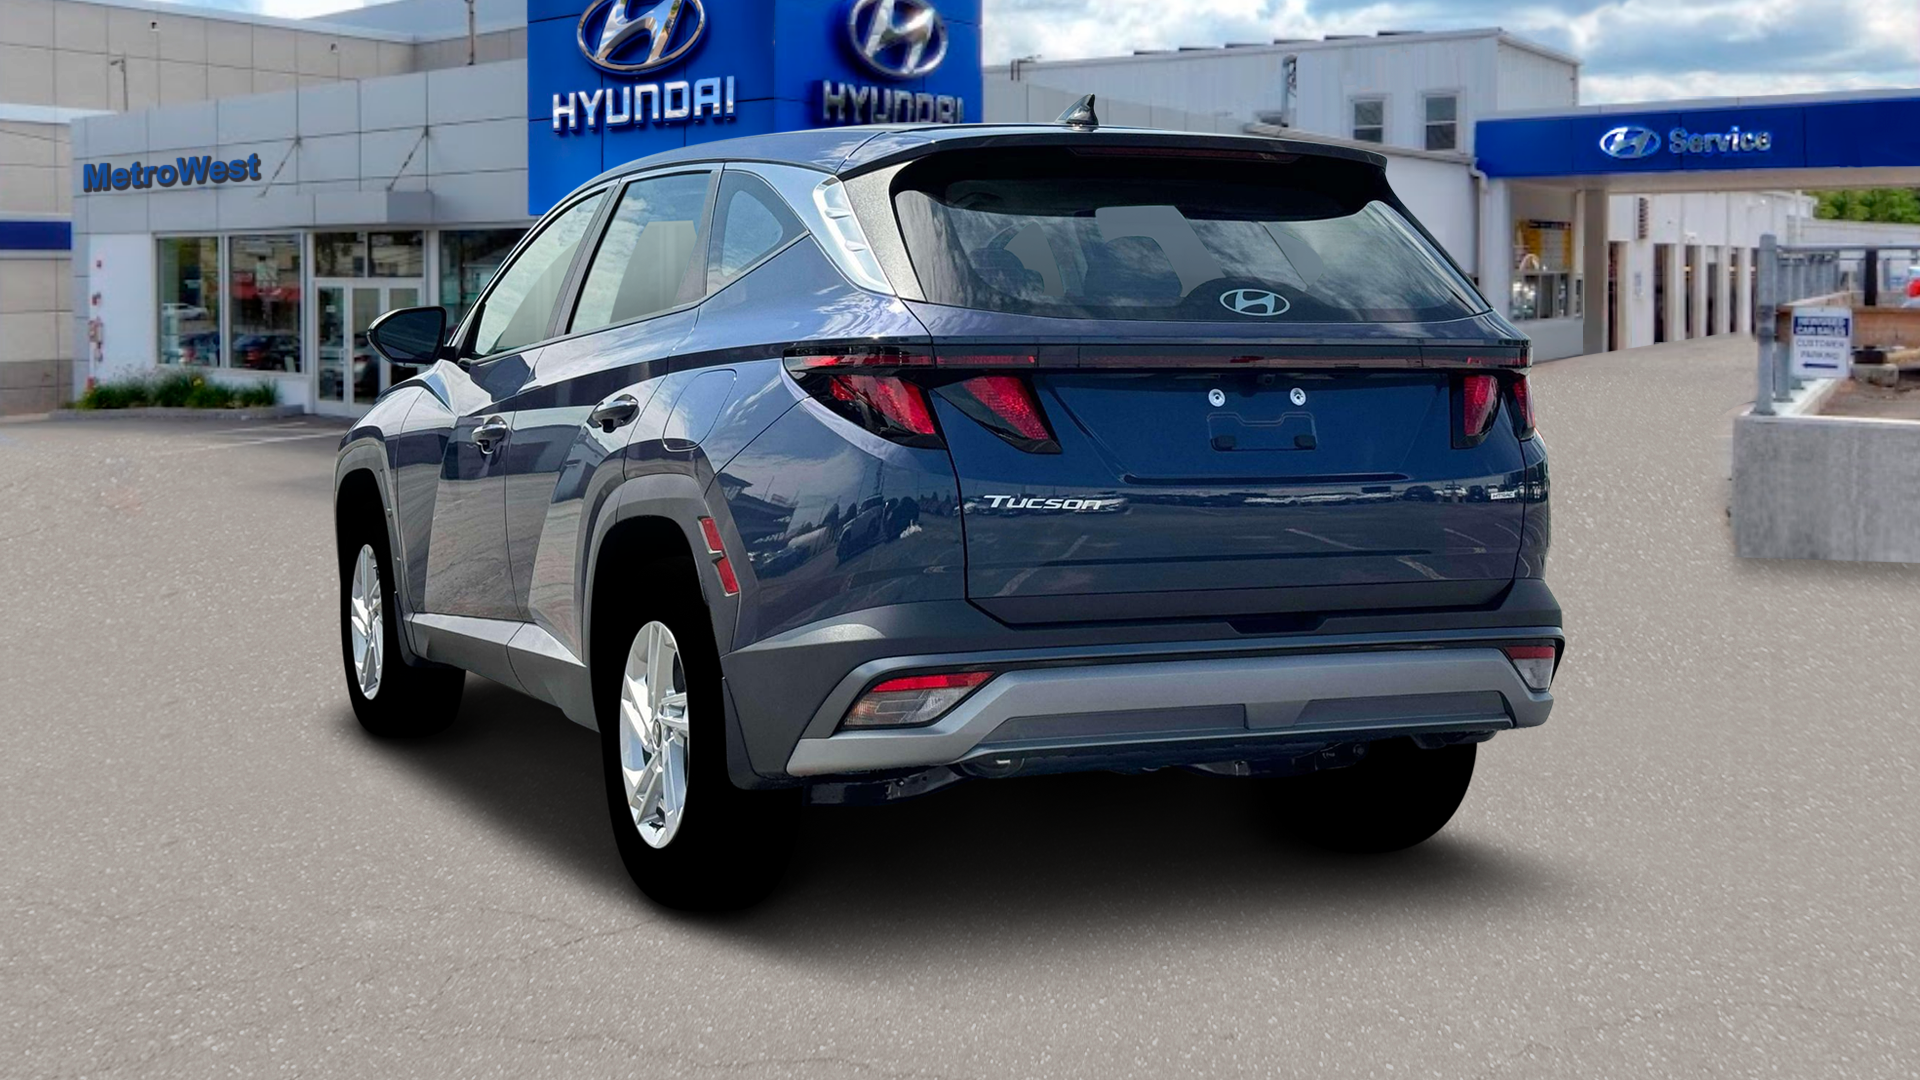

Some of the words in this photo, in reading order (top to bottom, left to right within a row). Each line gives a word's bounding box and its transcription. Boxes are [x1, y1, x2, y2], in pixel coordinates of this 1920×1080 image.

[552, 76, 736, 133] HYUNDAI
[822, 80, 965, 124] HYUNDAI
[1668, 126, 1772, 154] Service
[83, 153, 262, 193] MetroWest
[1796, 339, 1845, 348] CUSTOMER
[1800, 350, 1840, 360] PARKING
